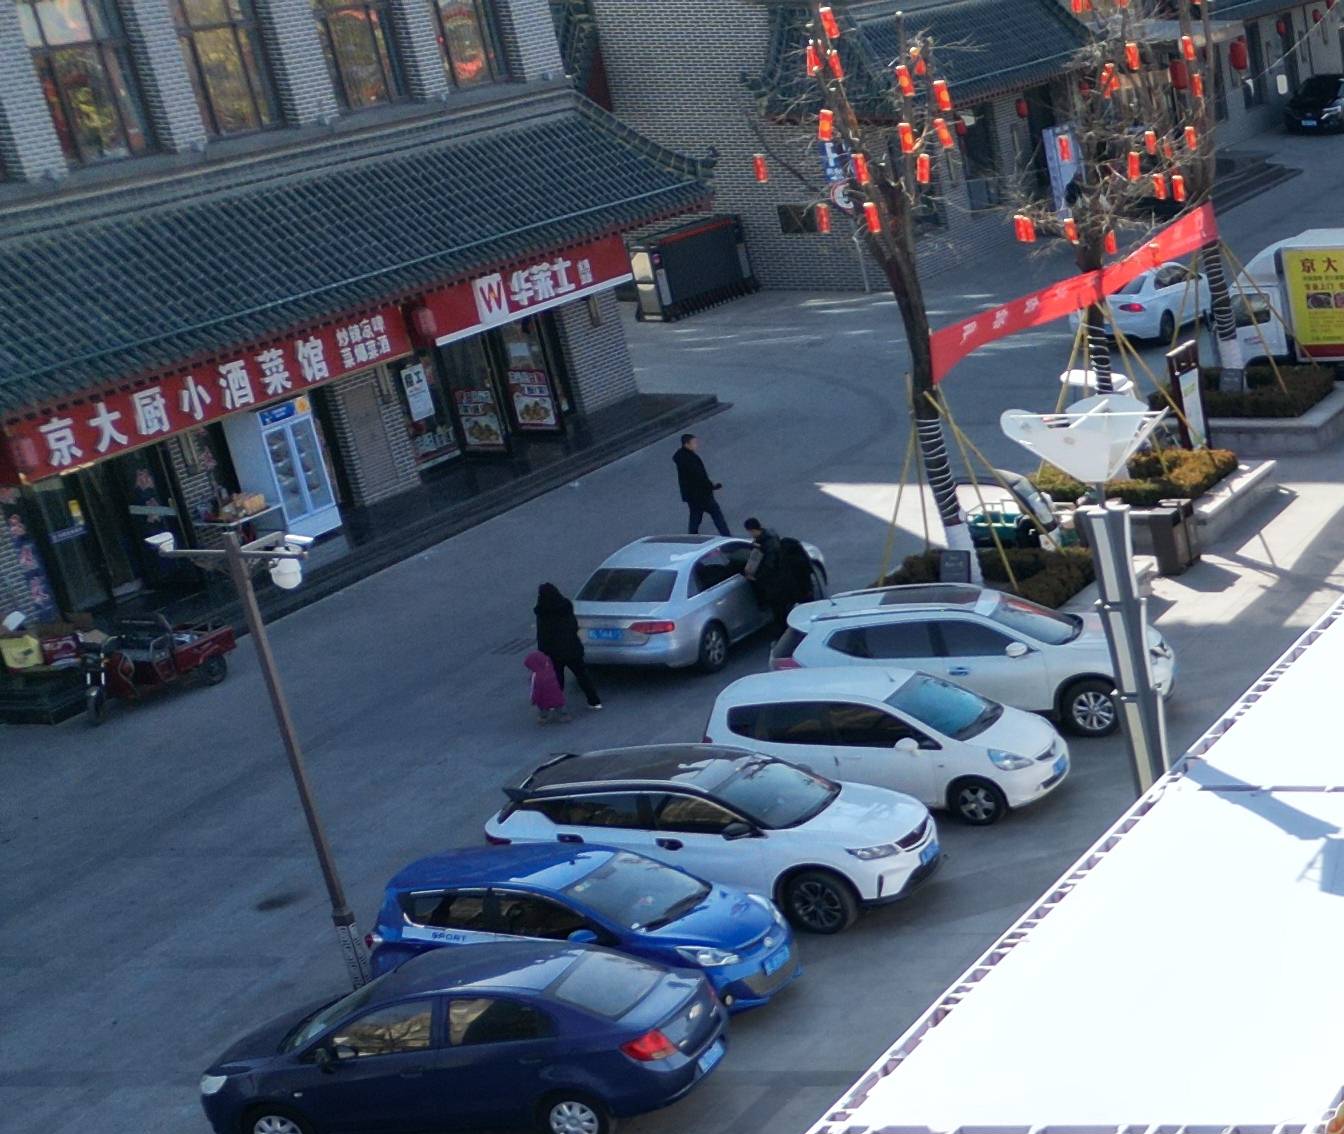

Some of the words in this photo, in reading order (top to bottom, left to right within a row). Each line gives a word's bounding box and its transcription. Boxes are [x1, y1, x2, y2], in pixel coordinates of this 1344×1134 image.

[511, 257, 575, 306] 华莱士
[40, 336, 330, 467] 京大厨小酒菜馆
